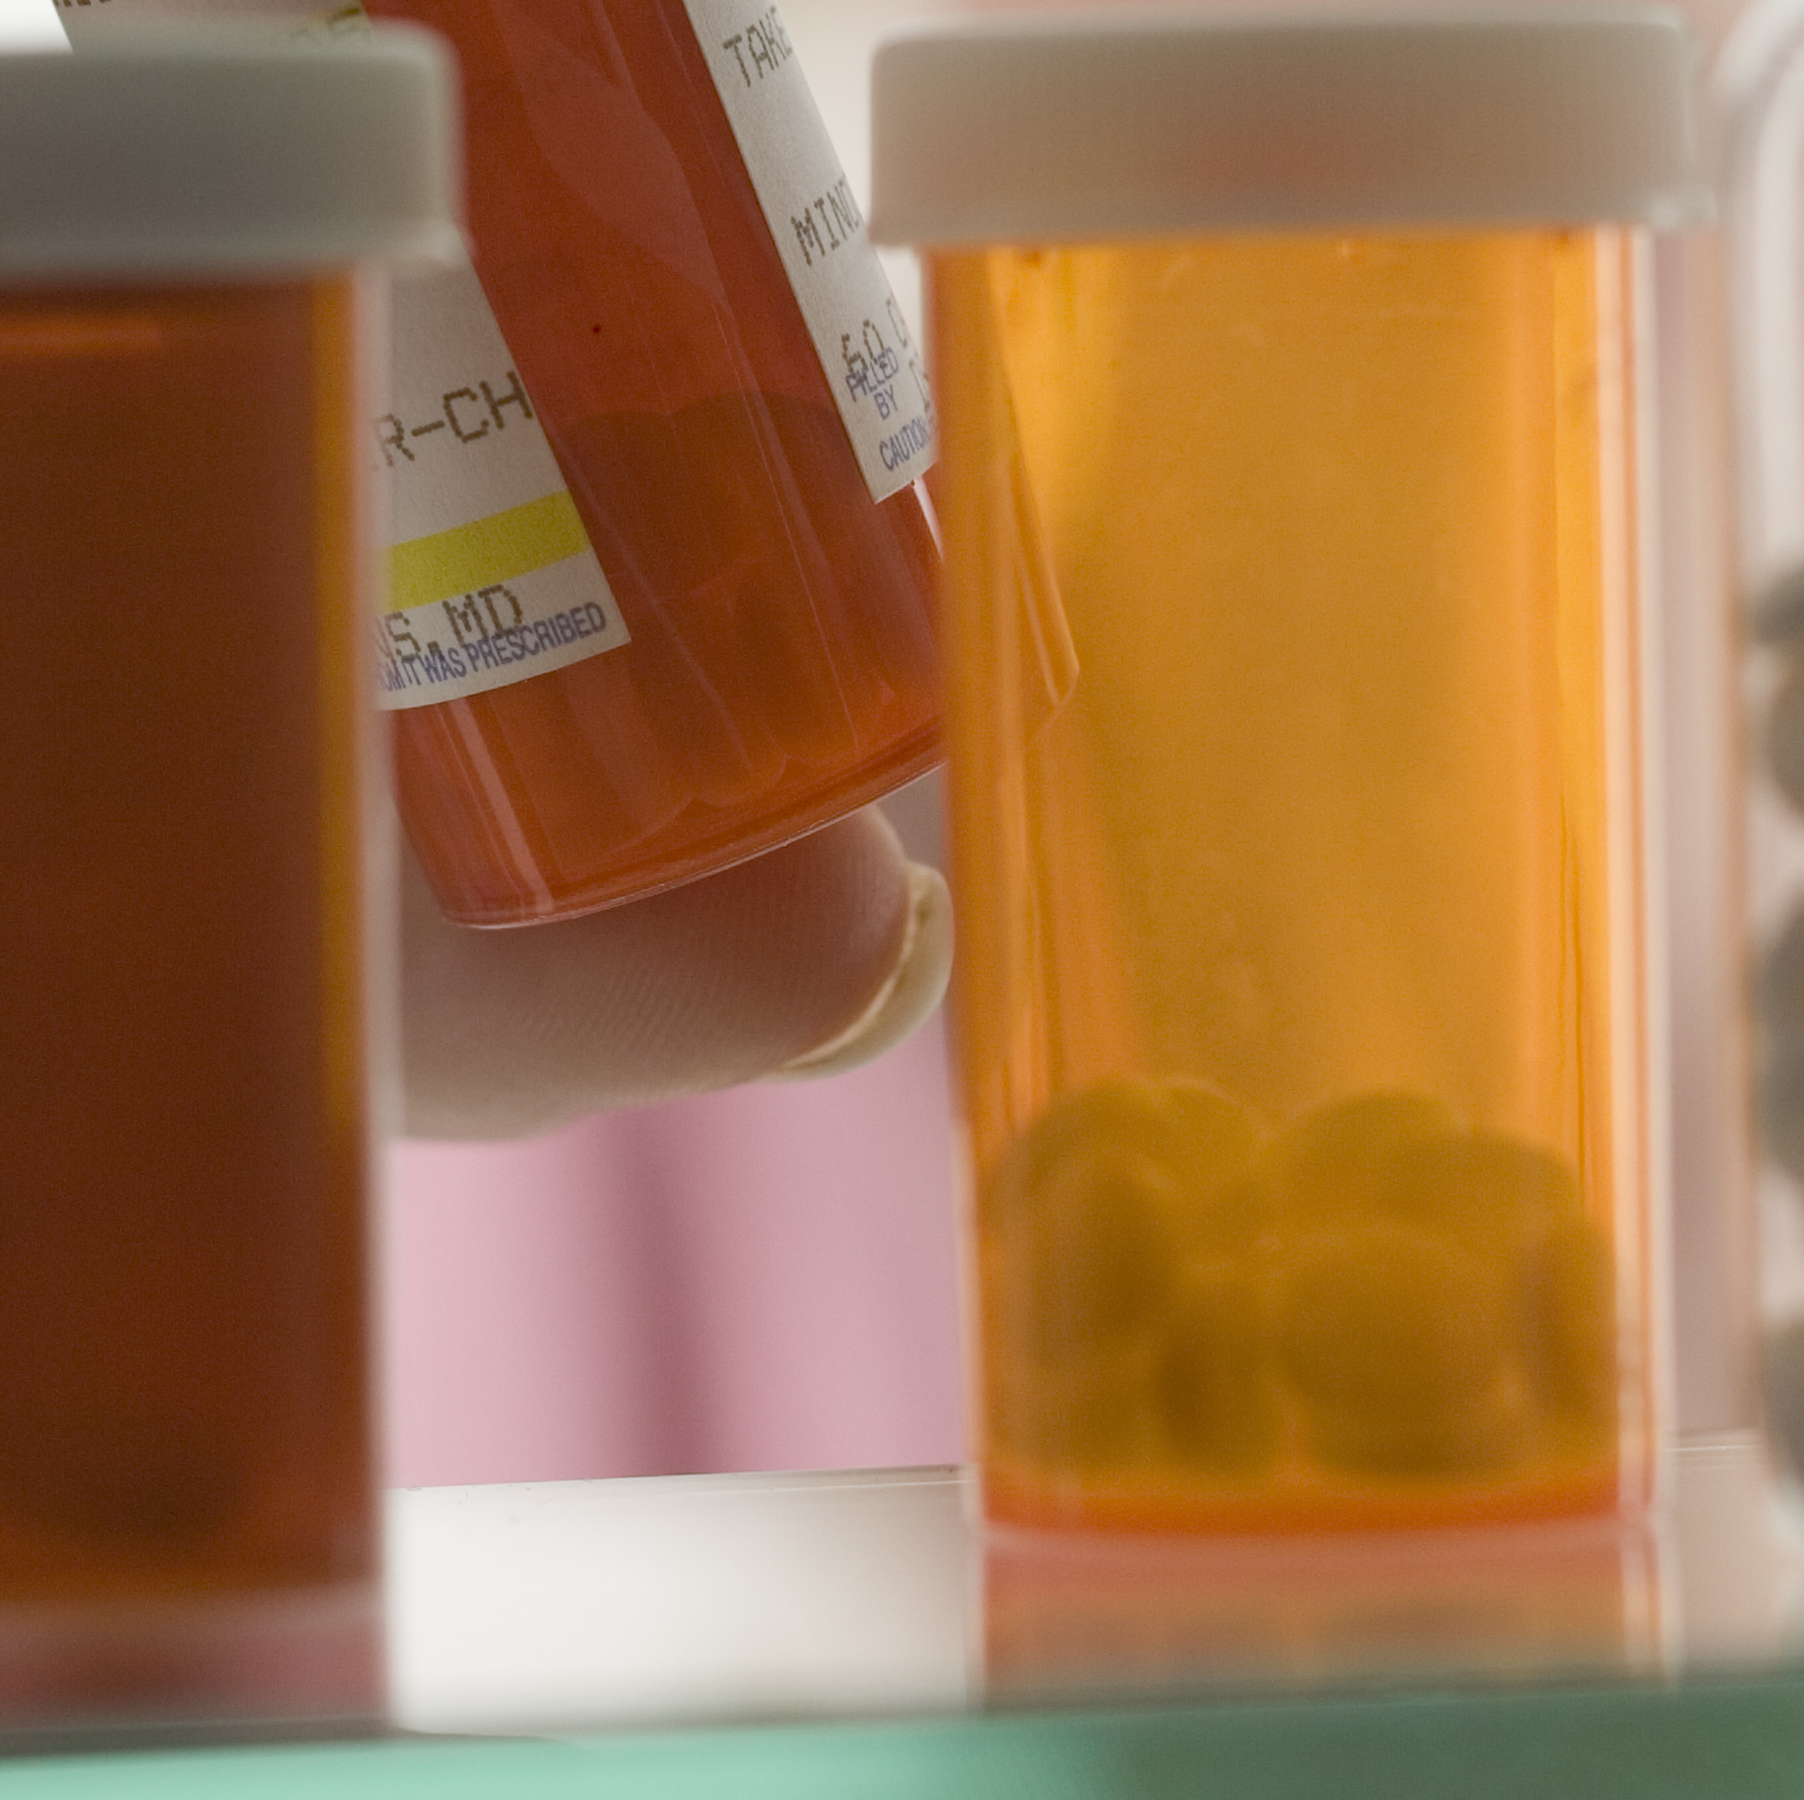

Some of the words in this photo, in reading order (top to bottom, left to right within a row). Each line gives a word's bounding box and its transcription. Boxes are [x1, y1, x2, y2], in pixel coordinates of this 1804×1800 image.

[874, 383, 899, 421] BY
[442, 584, 524, 643] MD
[463, 600, 608, 673] PRESCRIBED
